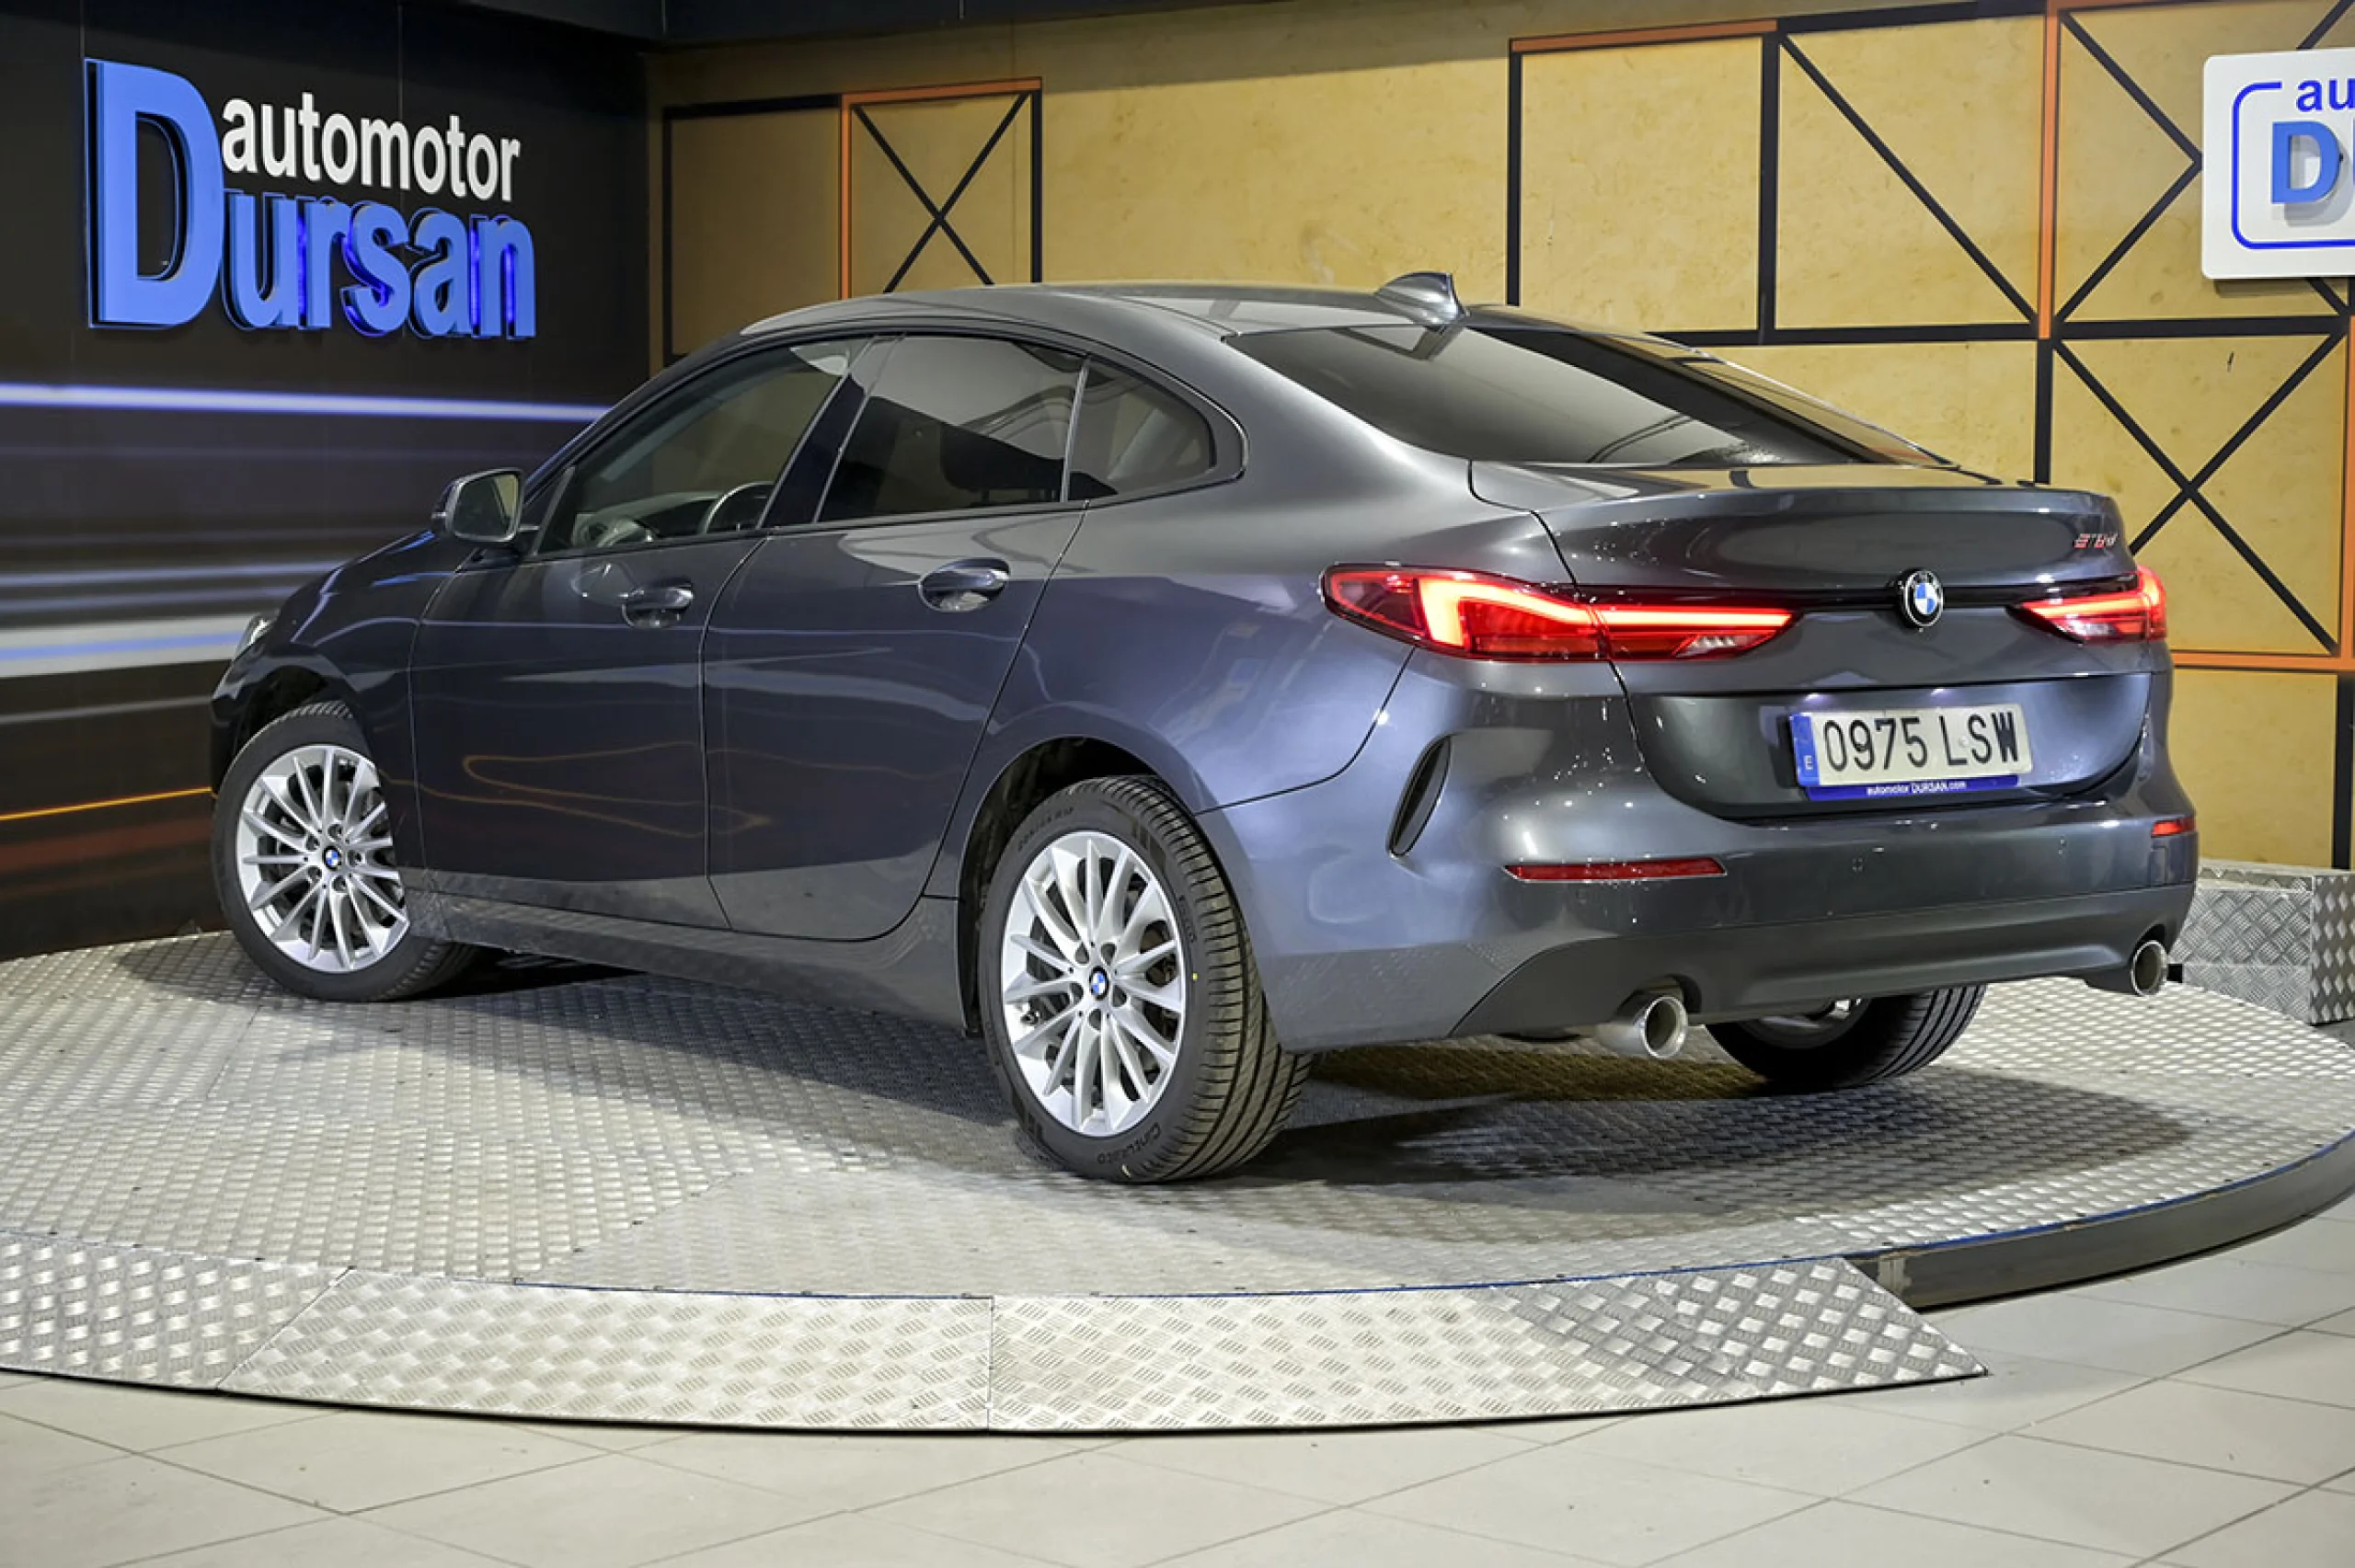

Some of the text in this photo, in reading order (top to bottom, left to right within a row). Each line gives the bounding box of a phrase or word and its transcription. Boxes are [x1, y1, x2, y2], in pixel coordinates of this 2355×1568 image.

[222, 92, 521, 201] automotor
[2272, 121, 2355, 204] D
[85, 58, 536, 338] Dursan
[1803, 755, 1813, 770] E
[1823, 711, 2019, 772] 0975 LSW
